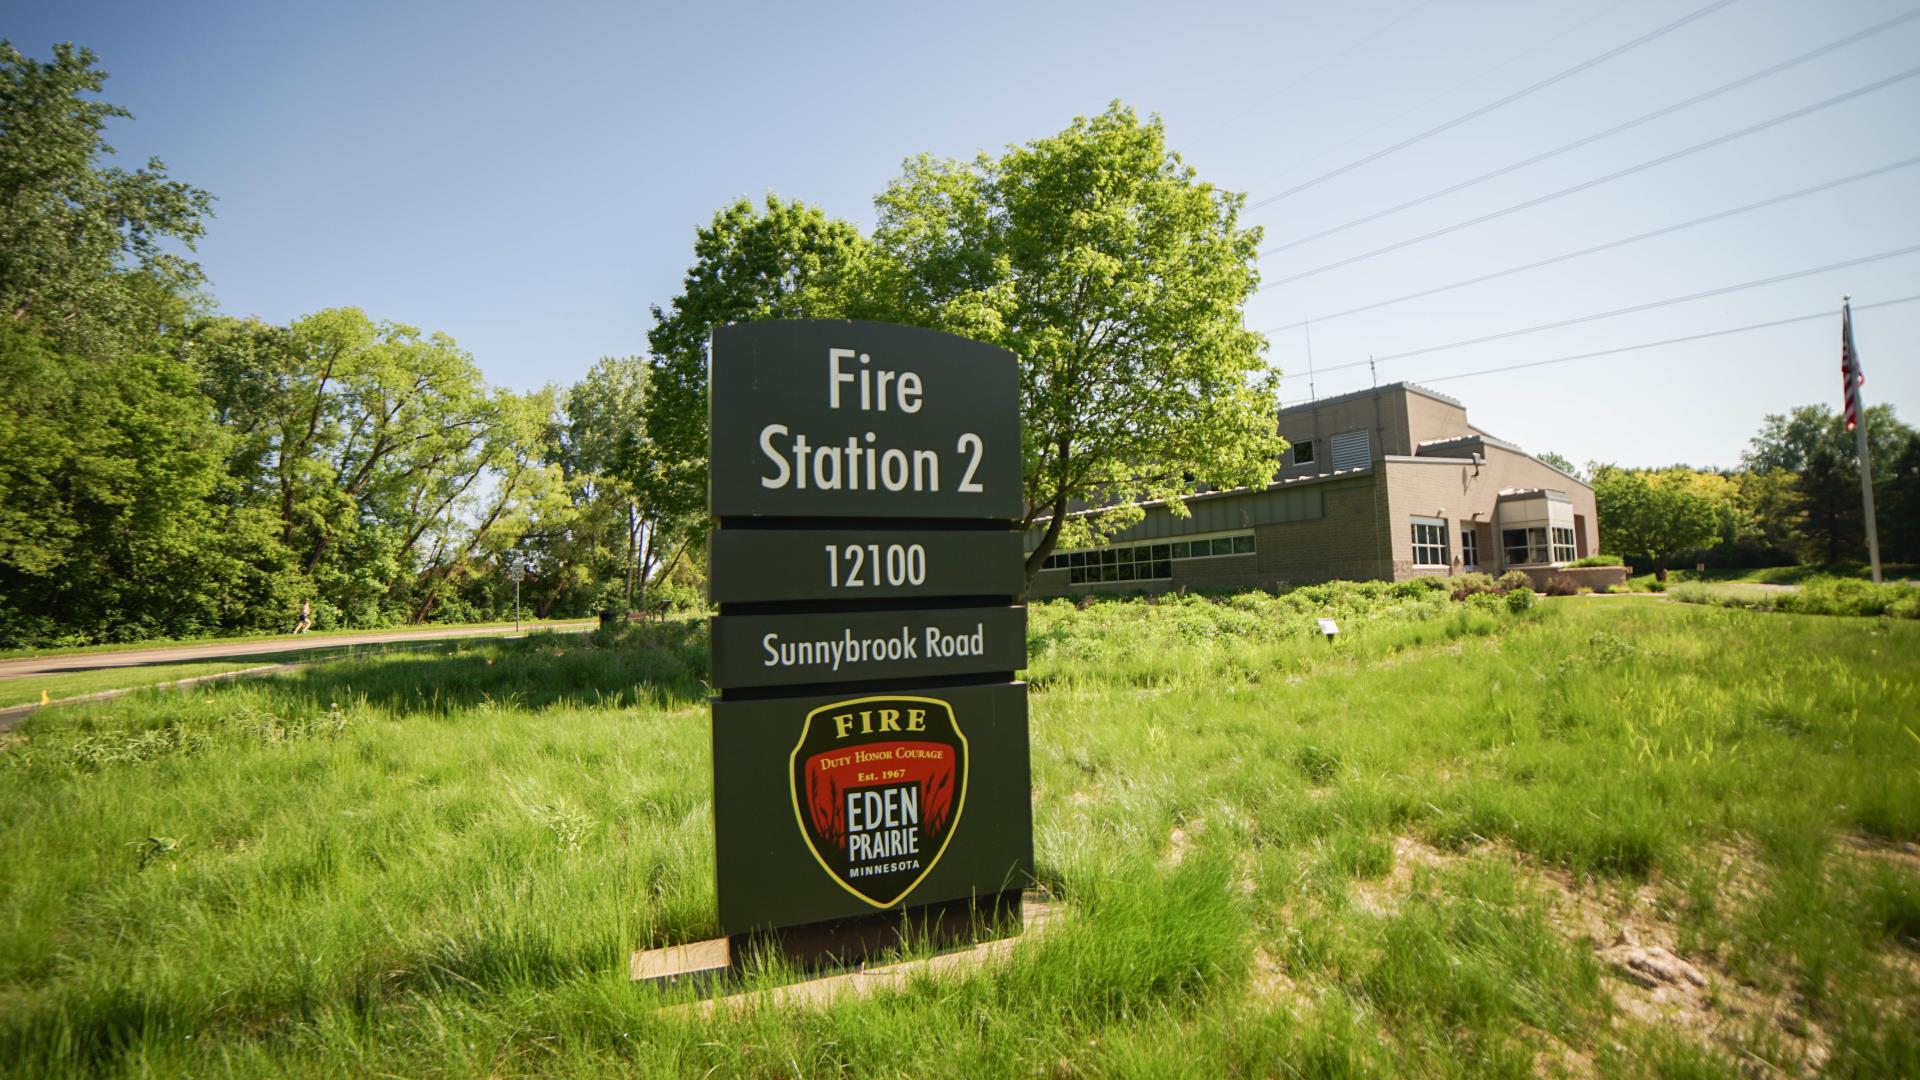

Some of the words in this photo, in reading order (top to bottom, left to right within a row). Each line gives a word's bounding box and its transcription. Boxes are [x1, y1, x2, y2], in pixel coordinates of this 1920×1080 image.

[829, 347, 923, 414] Fire
[759, 423, 939, 493] Station
[957, 432, 984, 493] 2
[825, 543, 926, 588] 12100
[762, 625, 918, 671] Sunnybrook
[925, 622, 984, 658] Road
[832, 708, 927, 739] FIRE
[858, 772, 879, 782] Est.
[882, 768, 906, 780] 1967
[847, 786, 919, 833] EDEN
[849, 827, 920, 862] PRAIRIE
[849, 859, 920, 878] MINNESOTA
